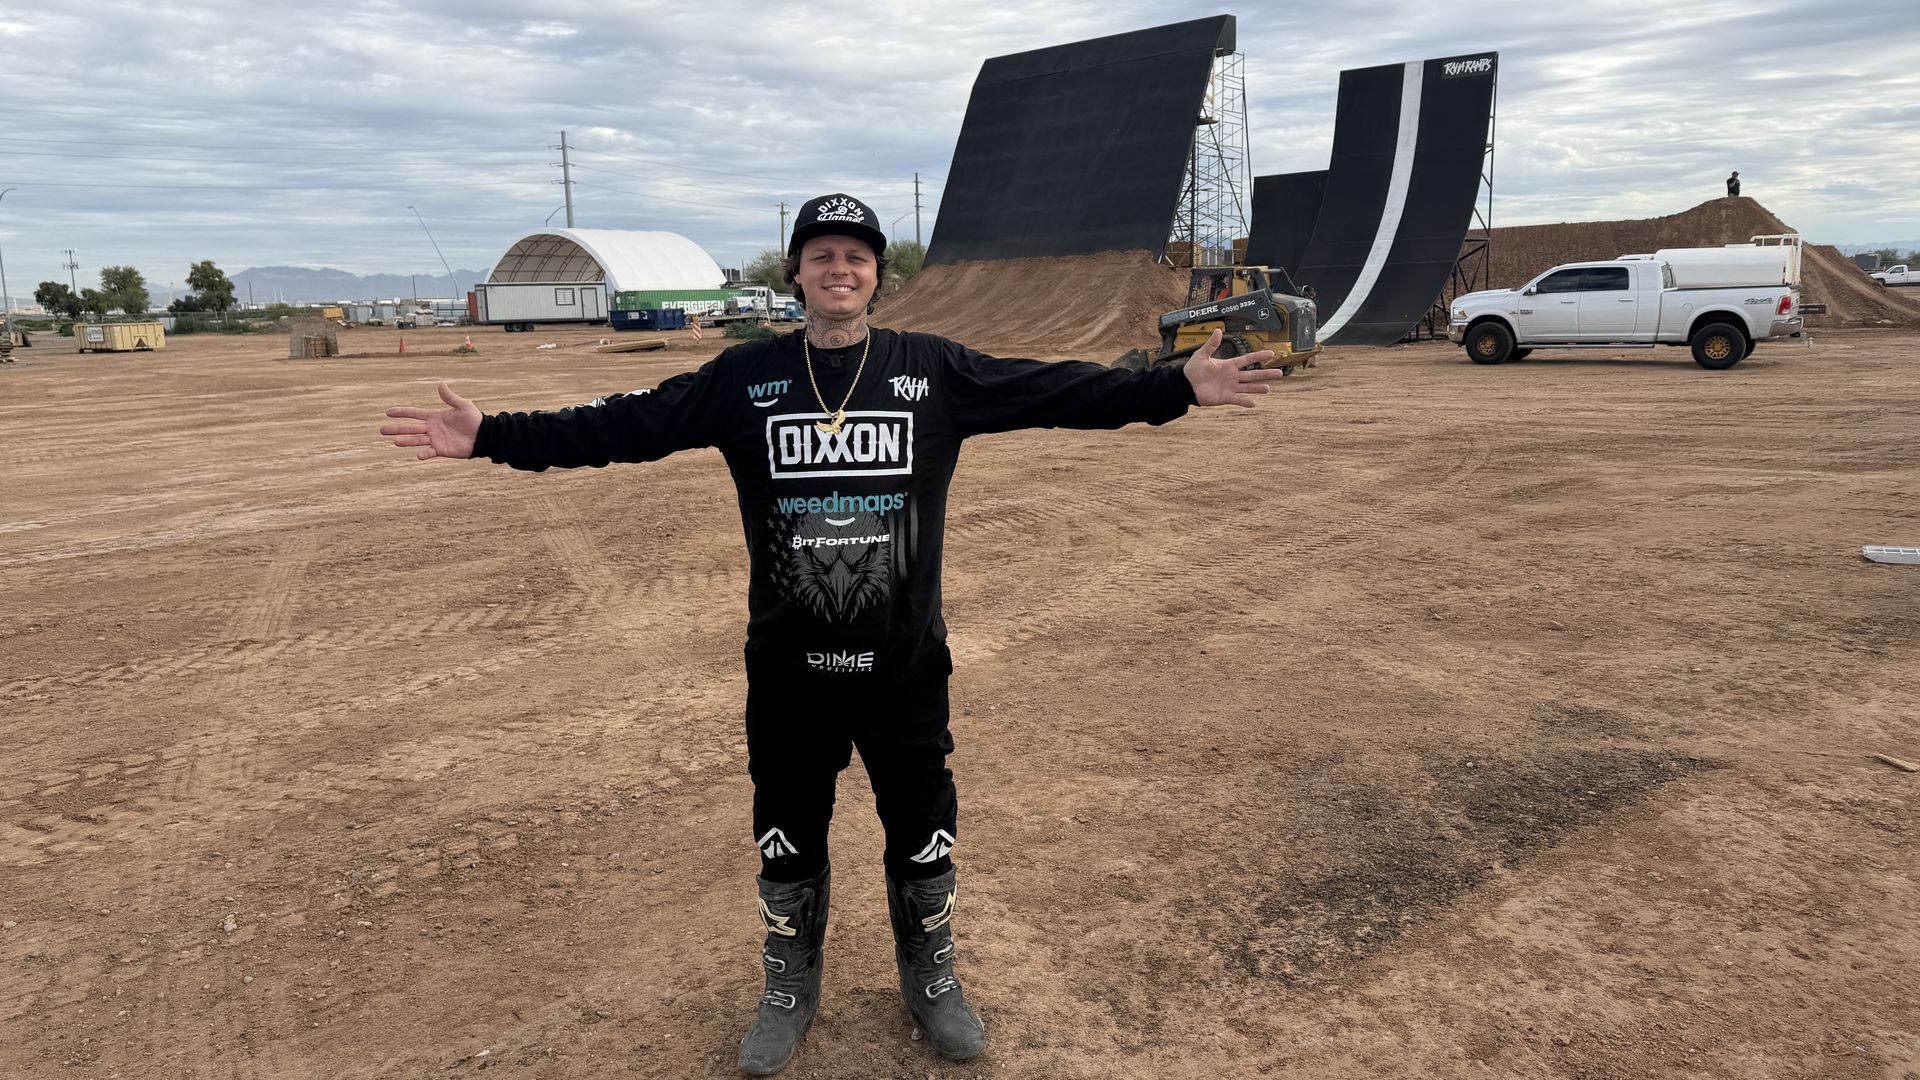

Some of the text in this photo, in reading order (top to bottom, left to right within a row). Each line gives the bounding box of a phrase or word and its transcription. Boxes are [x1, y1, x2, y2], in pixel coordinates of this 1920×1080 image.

[1464, 57, 1493, 73] RAMPS
[818, 197, 864, 216] DIXXON
[1189, 305, 1219, 319] DEERE
[779, 423, 901, 465] DIXXON
[777, 491, 906, 516] weedmaps
[806, 649, 875, 667] DIME
